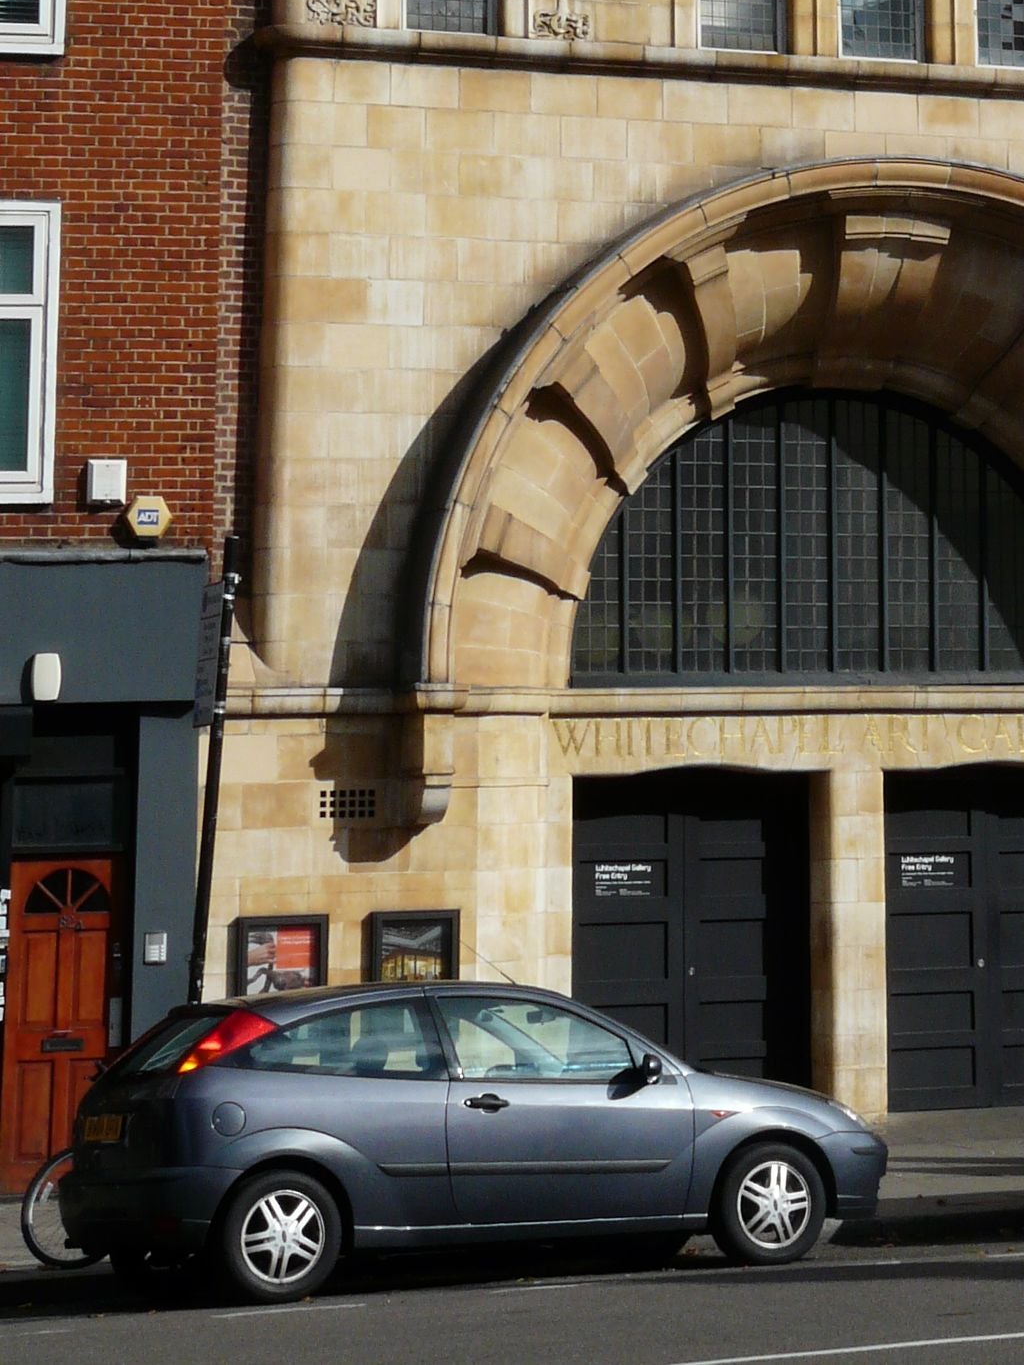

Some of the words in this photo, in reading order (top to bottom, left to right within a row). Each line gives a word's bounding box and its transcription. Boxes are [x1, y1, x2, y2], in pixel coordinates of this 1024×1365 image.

[137, 511, 159, 522] ADT
[549, 715, 845, 757] WHITECHAPEL
[861, 713, 941, 754] ART
[901, 856, 934, 864] Whitechapel
[935, 856, 953, 864] Gallery
[595, 864, 631, 872] Whitechapel
[632, 864, 651, 872] Gallery
